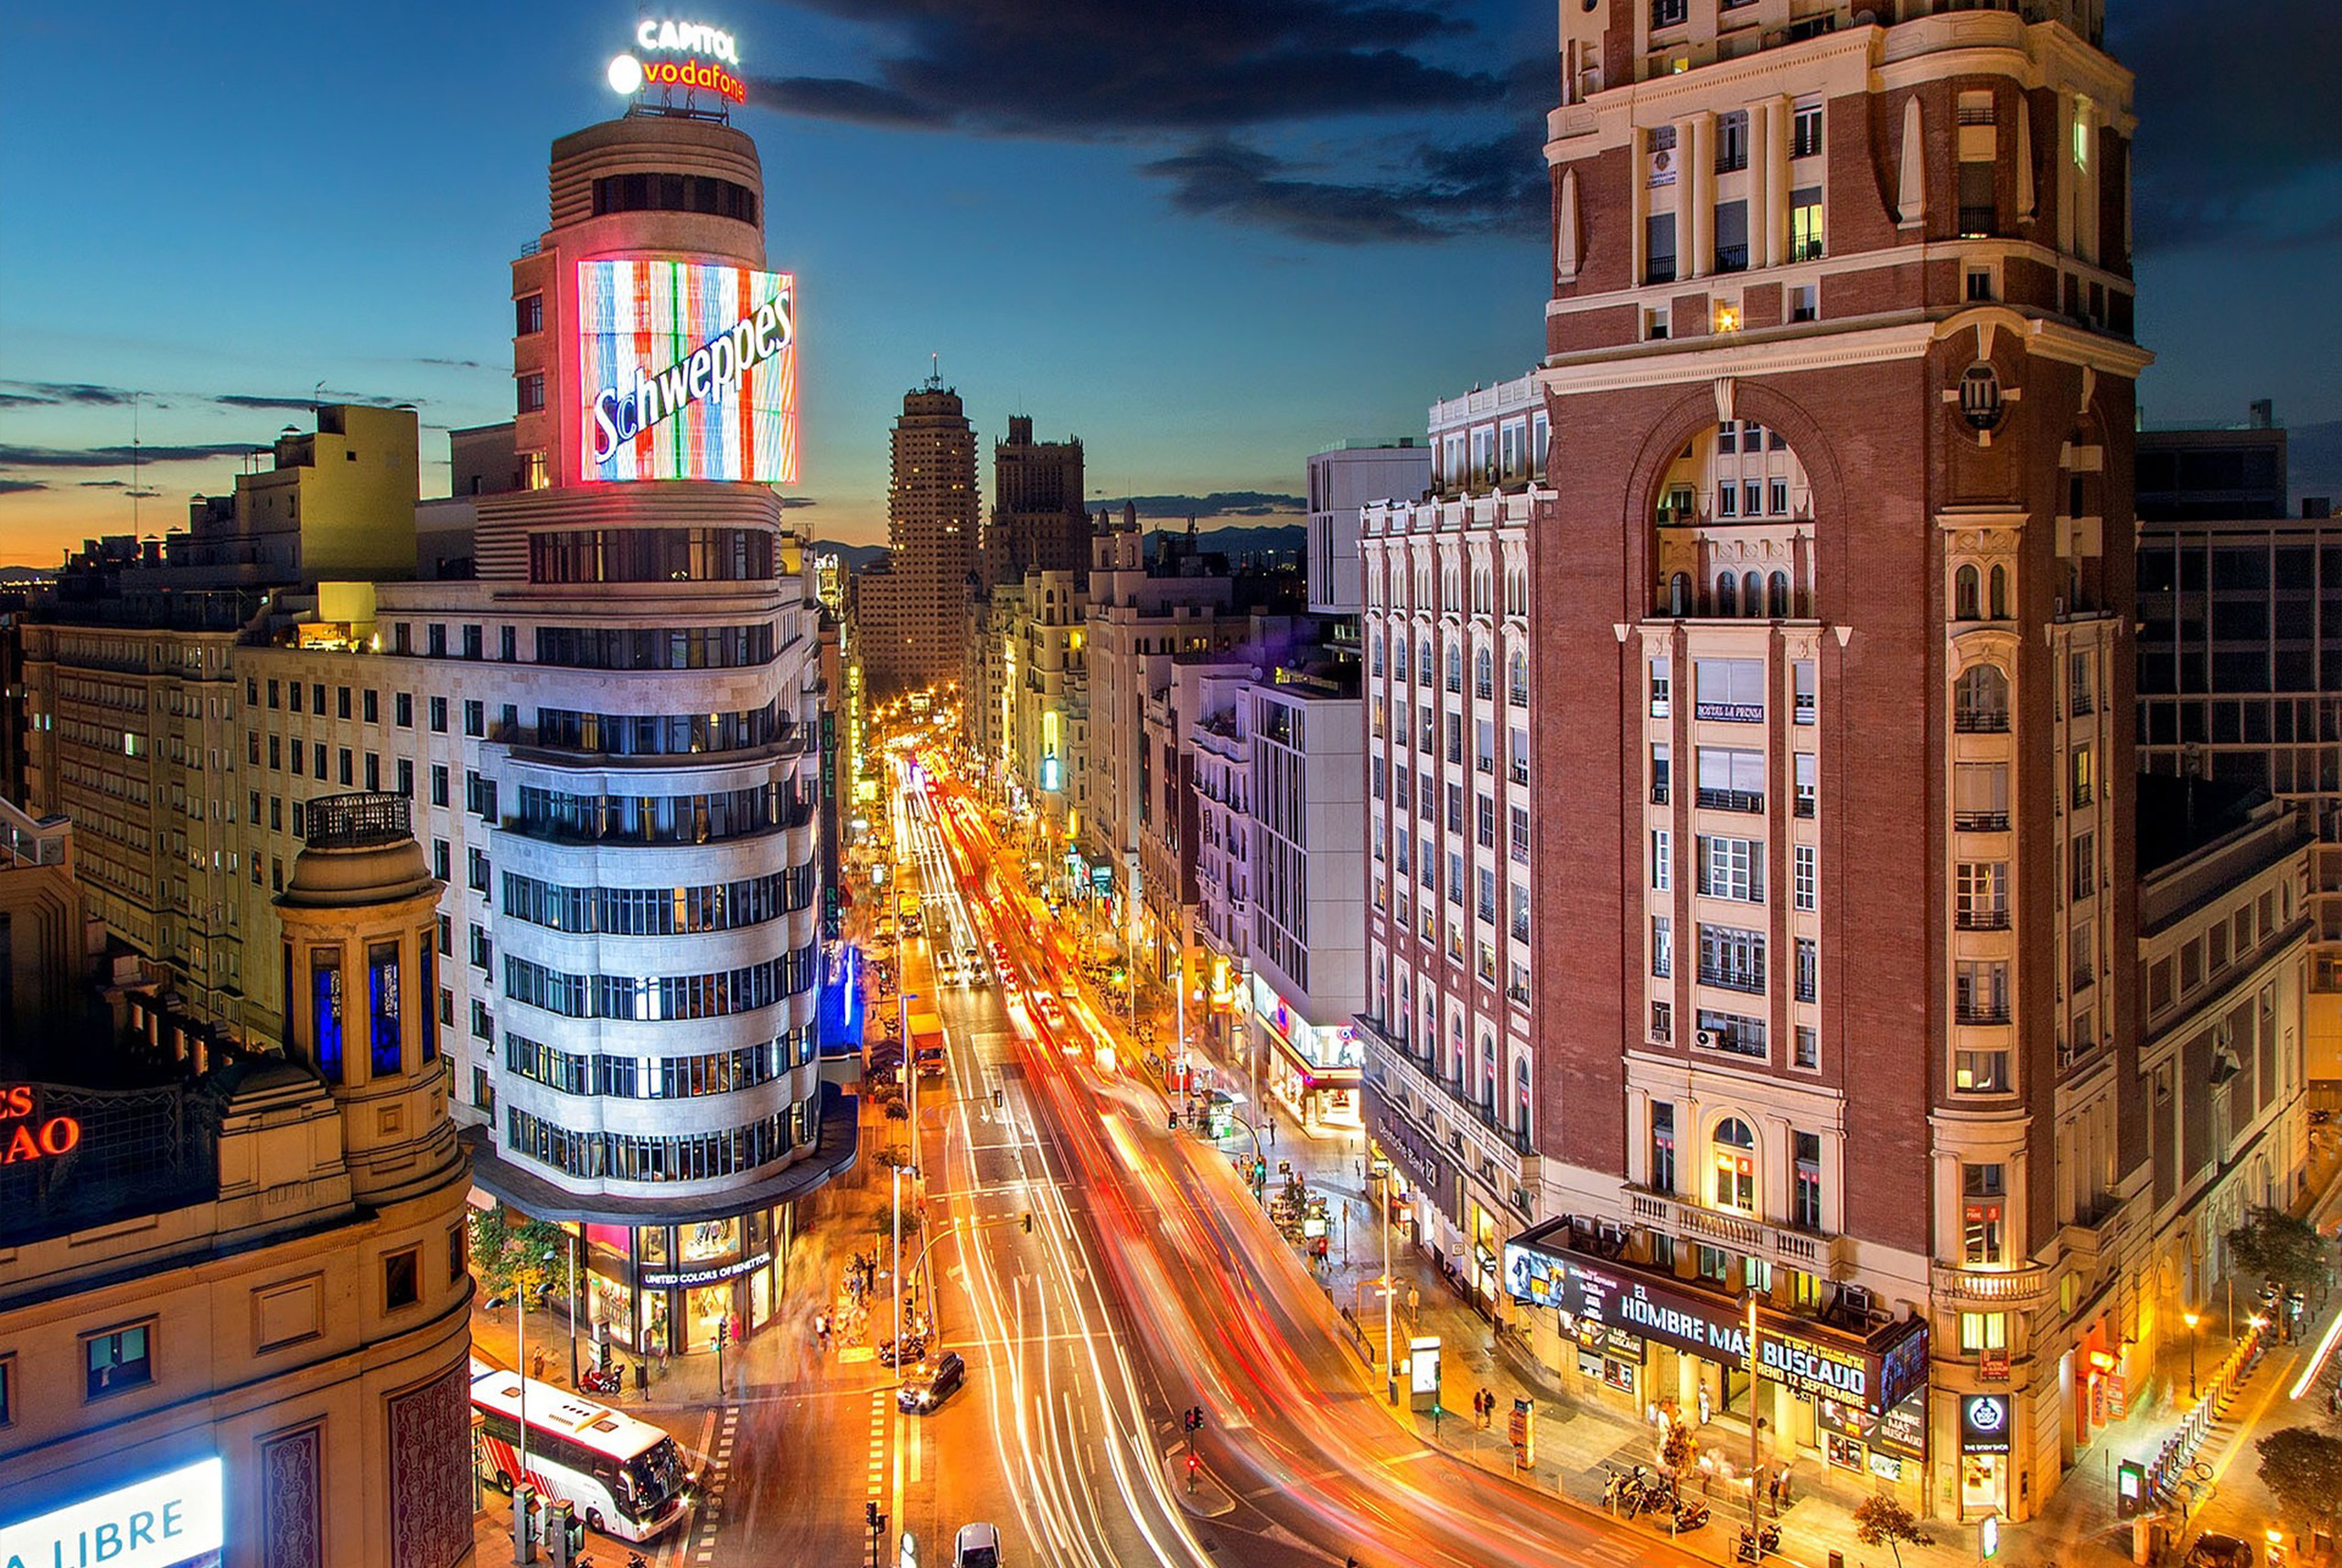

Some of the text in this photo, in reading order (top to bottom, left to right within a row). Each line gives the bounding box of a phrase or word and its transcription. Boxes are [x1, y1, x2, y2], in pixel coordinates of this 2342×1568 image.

[638, 20, 738, 65] CAPITOL
[643, 59, 745, 104] vodafone
[595, 285, 791, 464] Schweppes
[824, 718, 837, 934] HOTEL REX
[0, 1117, 79, 1164] AO
[1408, 1148, 1424, 1177] Bank
[645, 1251, 770, 1284] UNITED COLORS OF BENETTON
[1634, 1283, 1648, 1301] EL
[1621, 1295, 1703, 1342] HOMBRE
[1763, 1340, 1865, 1395] BUSCADO
[1741, 1356, 1784, 1382] ESRENO
[1786, 1372, 1799, 1386] 12
[1801, 1377, 1865, 1409] SEPTIEMBRE
[54, 1499, 182, 1568] LIBRE
